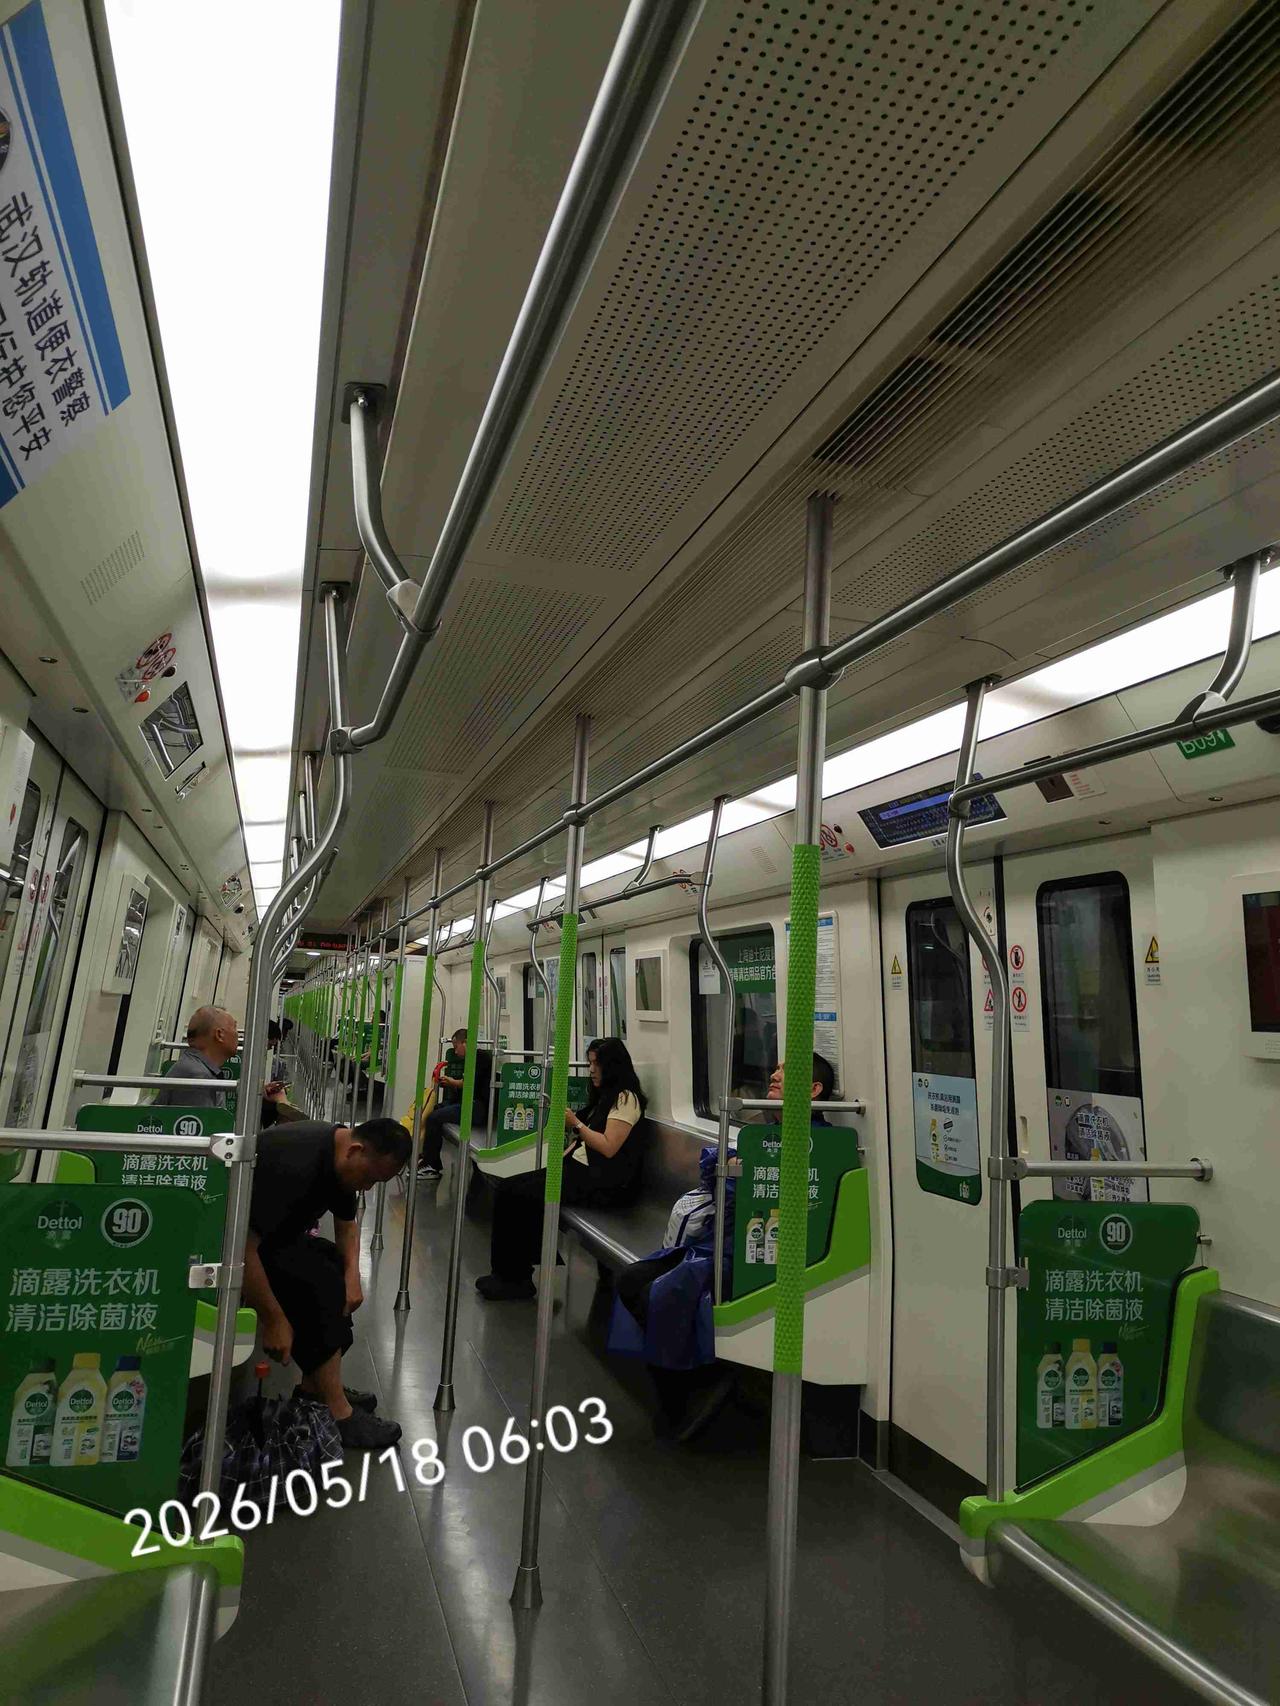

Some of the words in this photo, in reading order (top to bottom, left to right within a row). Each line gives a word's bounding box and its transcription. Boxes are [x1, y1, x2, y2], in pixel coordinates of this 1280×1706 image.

[0, 191, 90, 427] 武汉轨道便衣警察
[137, 1124, 163, 1133] Dettol
[179, 1120, 197, 1136] 90
[122, 1154, 208, 1171] 滴露洗衣机
[753, 1166, 820, 1182] 滴露机
[752, 1184, 819, 1199] 清洁液
[37, 1215, 83, 1230] Dettol
[112, 1208, 142, 1234] 90
[1057, 1227, 1087, 1239] Dettol
[1106, 1221, 1126, 1242] 90
[8, 1267, 161, 1297] 滴露洗衣机
[1045, 1269, 1144, 1293] 滴露洗衣机
[5, 1302, 159, 1333] 清洁除菌液
[1045, 1298, 1144, 1322] 清洁除菌液
